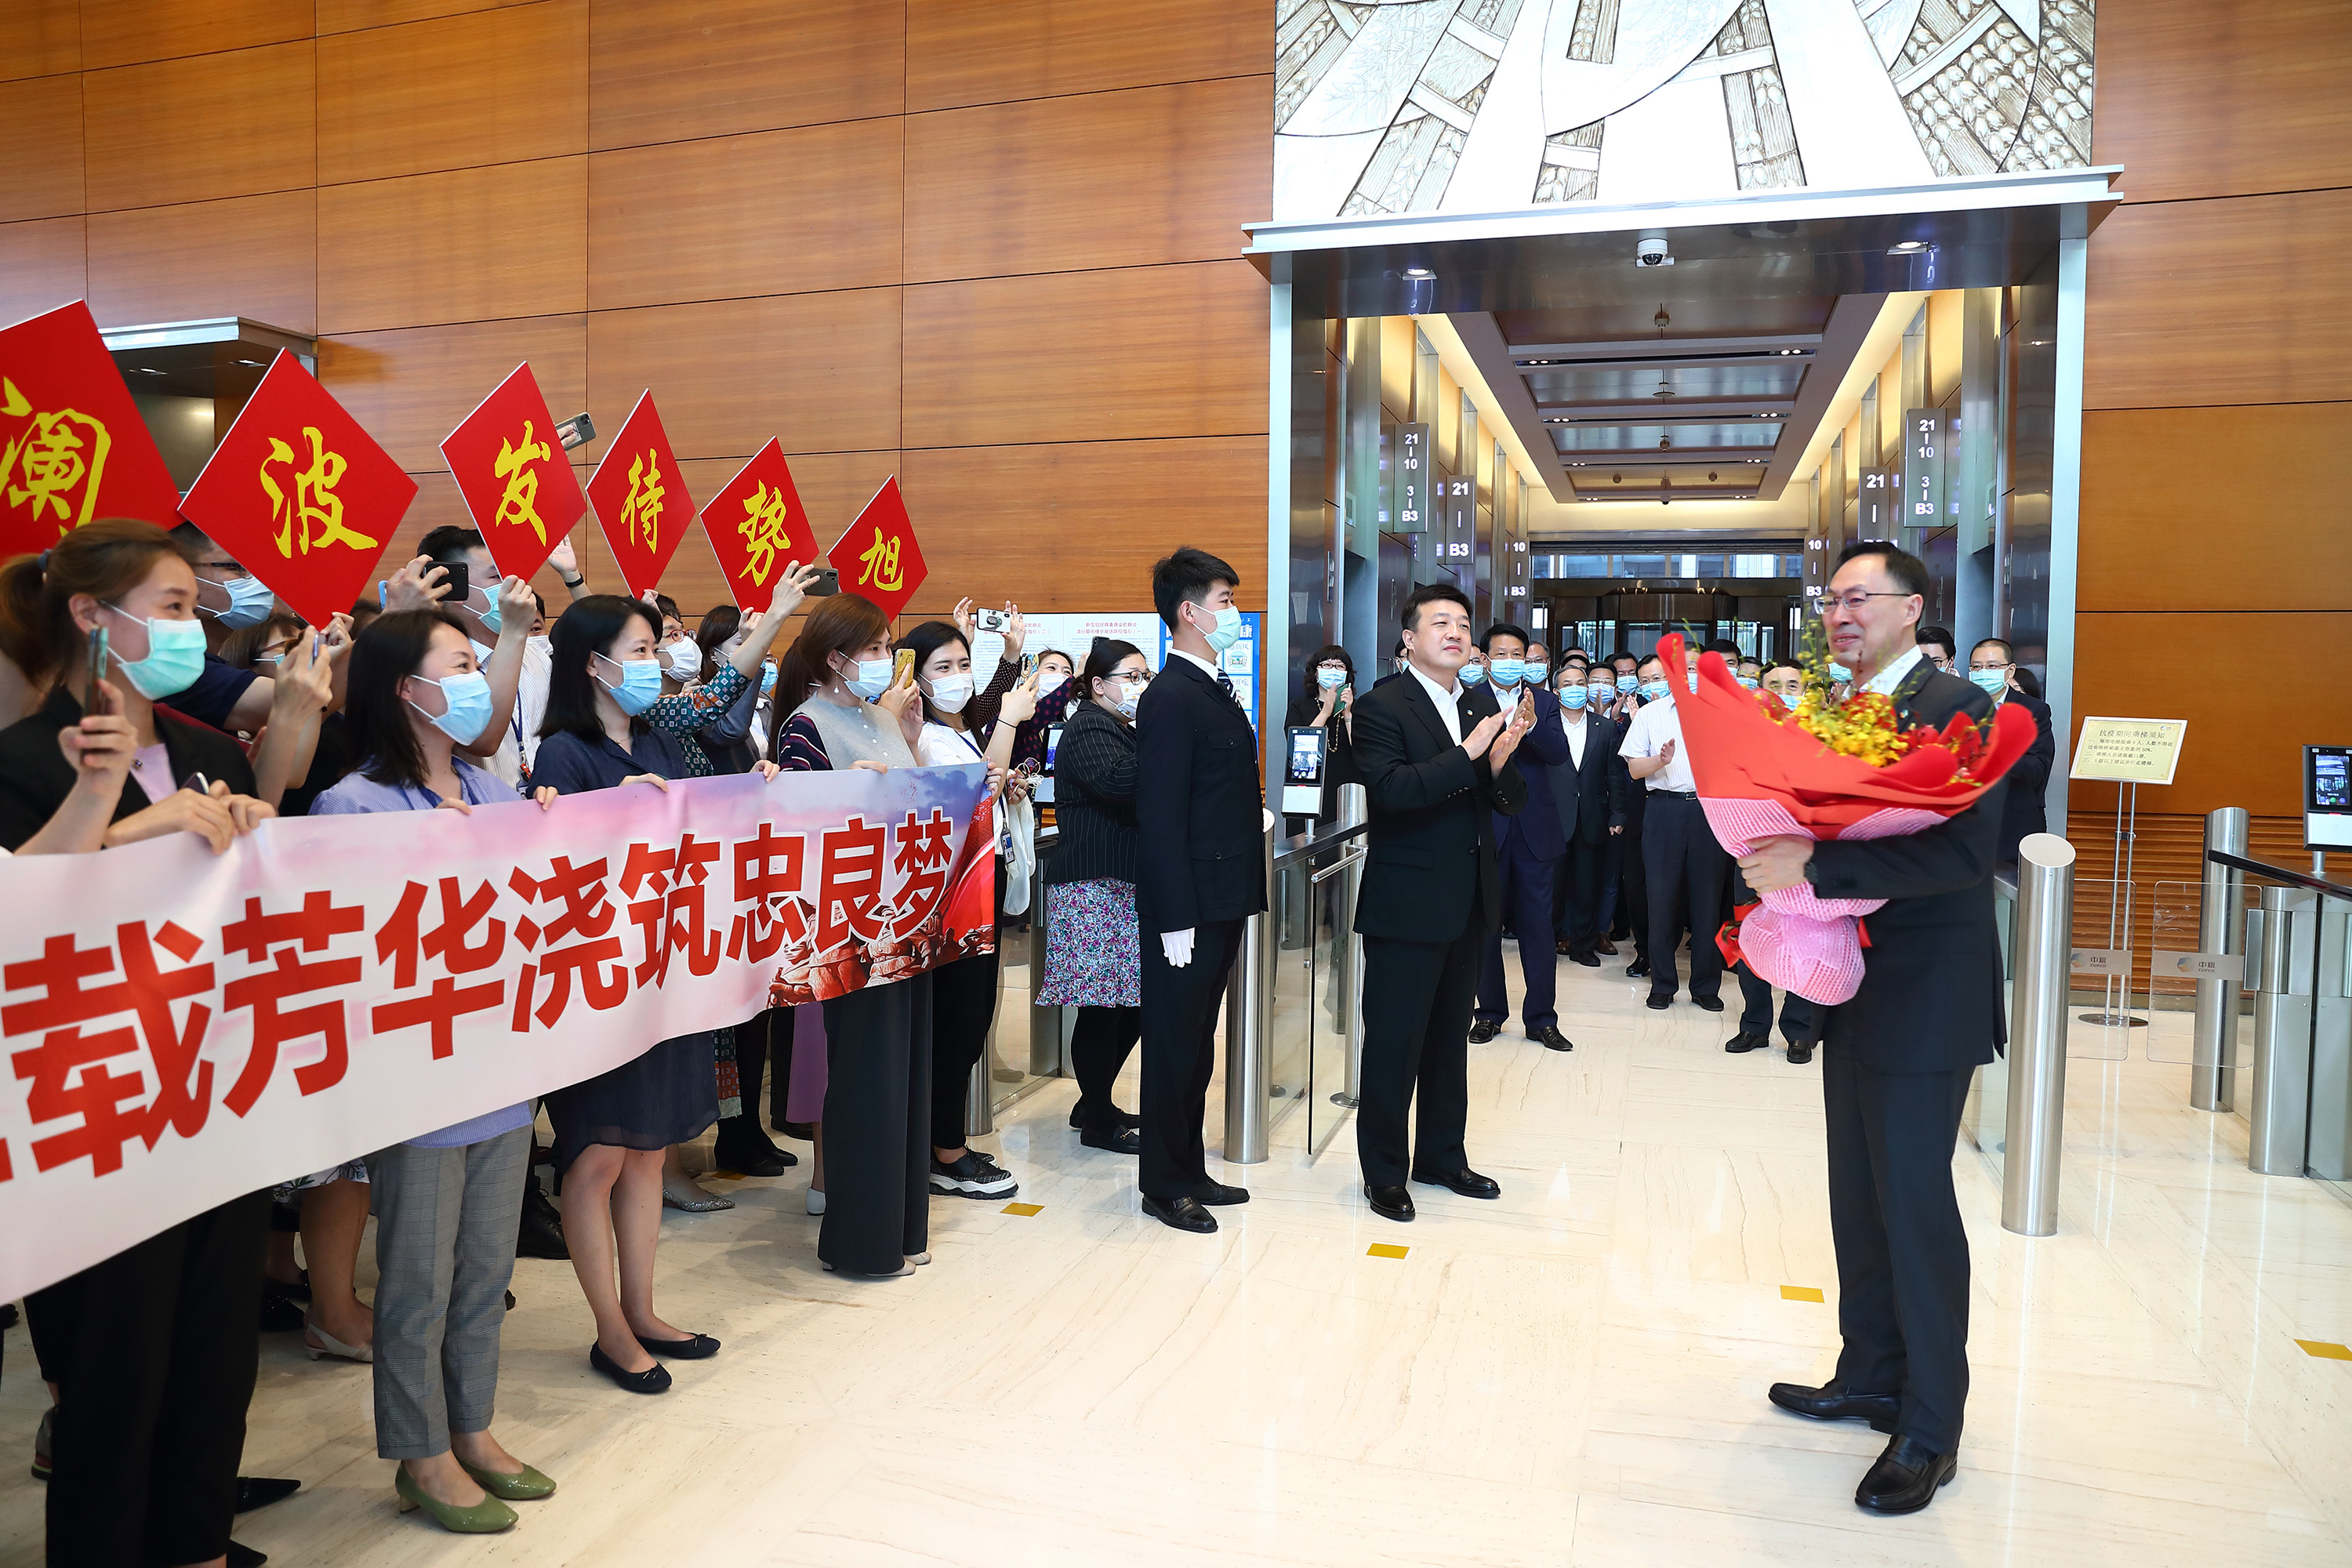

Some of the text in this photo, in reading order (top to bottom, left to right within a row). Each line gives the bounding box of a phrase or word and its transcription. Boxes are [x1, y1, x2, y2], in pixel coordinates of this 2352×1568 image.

[1918, 419, 1935, 431] 21
[1404, 433, 1418, 445] 21
[1918, 446, 1934, 459] 10
[1403, 458, 1418, 470] 10
[494, 419, 551, 547] 发
[1866, 474, 1885, 488] 21
[1921, 476, 1930, 488] 3
[260, 426, 379, 559] 波
[1406, 485, 1414, 496] 3
[1452, 481, 1469, 495] 21
[620, 448, 666, 555] 待
[1915, 503, 1934, 515] B3
[1401, 510, 1419, 522] B3
[737, 479, 792, 587] 势
[1449, 543, 1469, 557] B3
[1513, 542, 1526, 553] 10
[1808, 539, 1822, 550] 10
[858, 526, 905, 592] 旭
[1511, 586, 1526, 597] B3
[1806, 586, 1823, 597] B3
[2099, 729, 2165, 739] 抗疫期间乘梯须知
[0, 808, 953, 1182] 载芳华浇筑忠良梦
